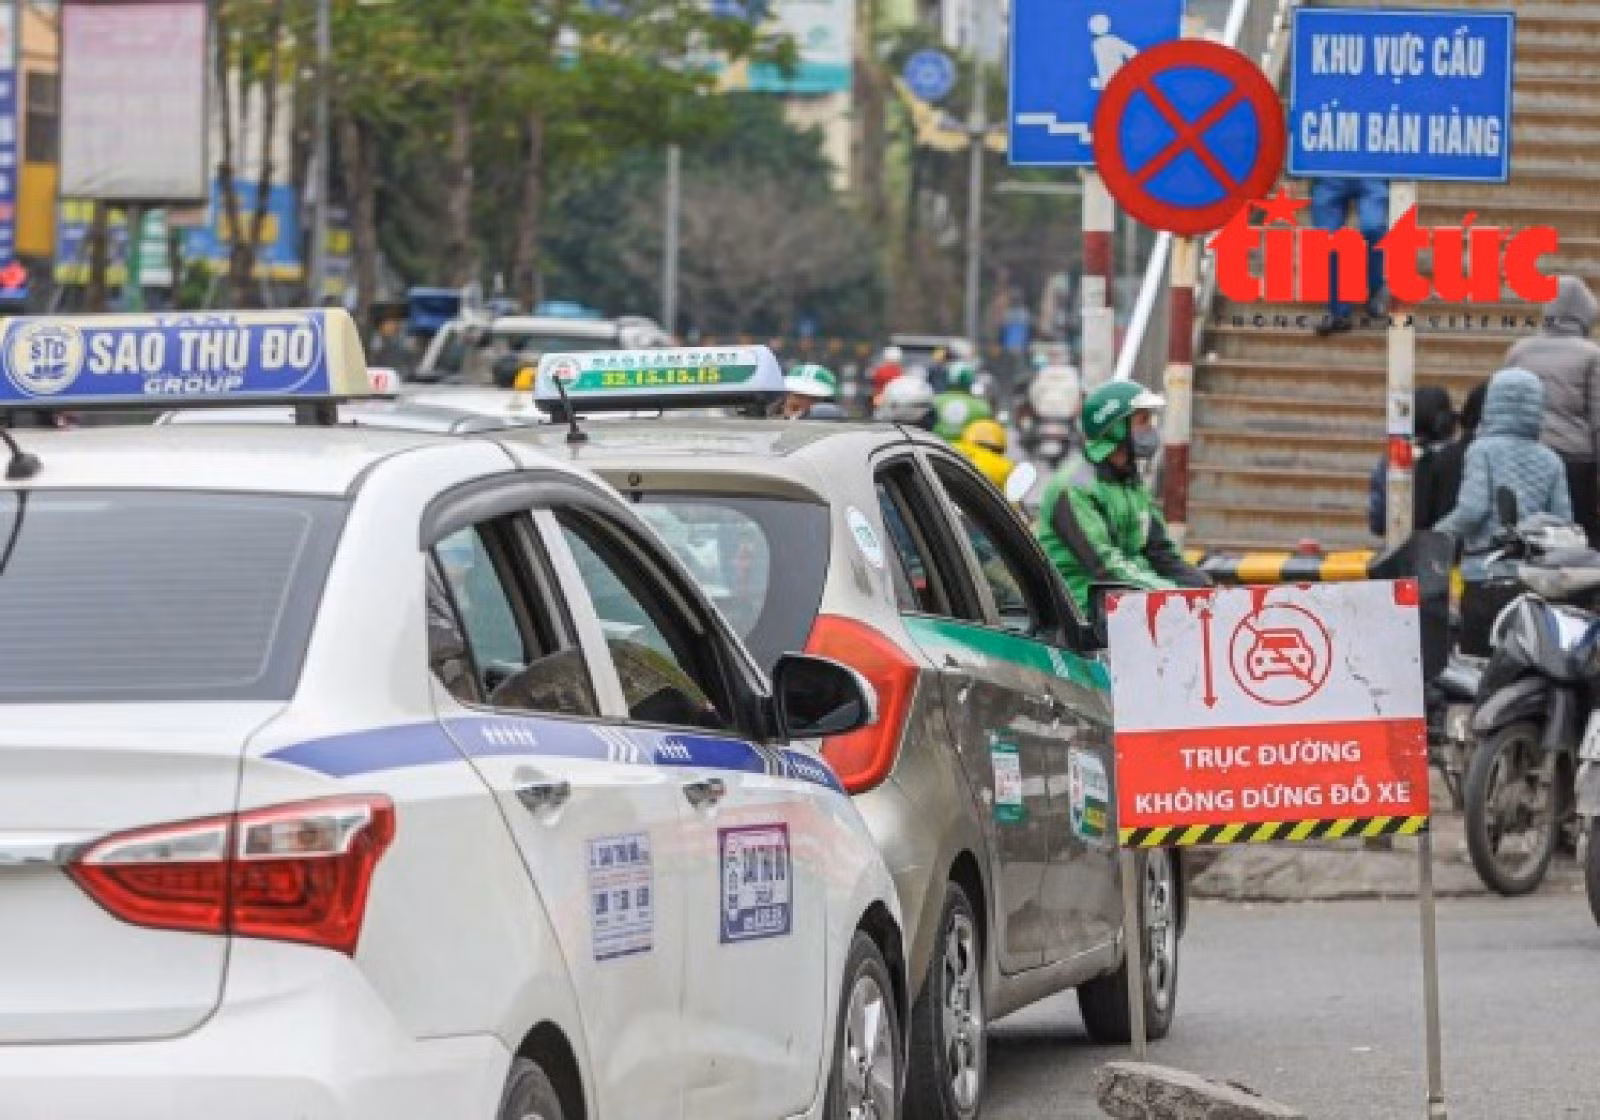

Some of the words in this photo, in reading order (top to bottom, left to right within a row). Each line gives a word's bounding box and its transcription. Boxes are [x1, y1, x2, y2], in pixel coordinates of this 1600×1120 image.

[1312, 33, 1363, 75] KHU
[1374, 31, 1424, 84] VỰC
[1301, 98, 1360, 151] CẤM
[1367, 103, 1420, 153] BÁN
[1429, 105, 1500, 156] HÀNG
[88, 332, 165, 374] SAO
[1180, 746, 1250, 773] TRỤC
[1258, 739, 1361, 763] ĐƯỜNG
[1135, 784, 1233, 813] KHÔNG
[1243, 782, 1322, 808] DỪNG
[1377, 780, 1411, 804] XE
